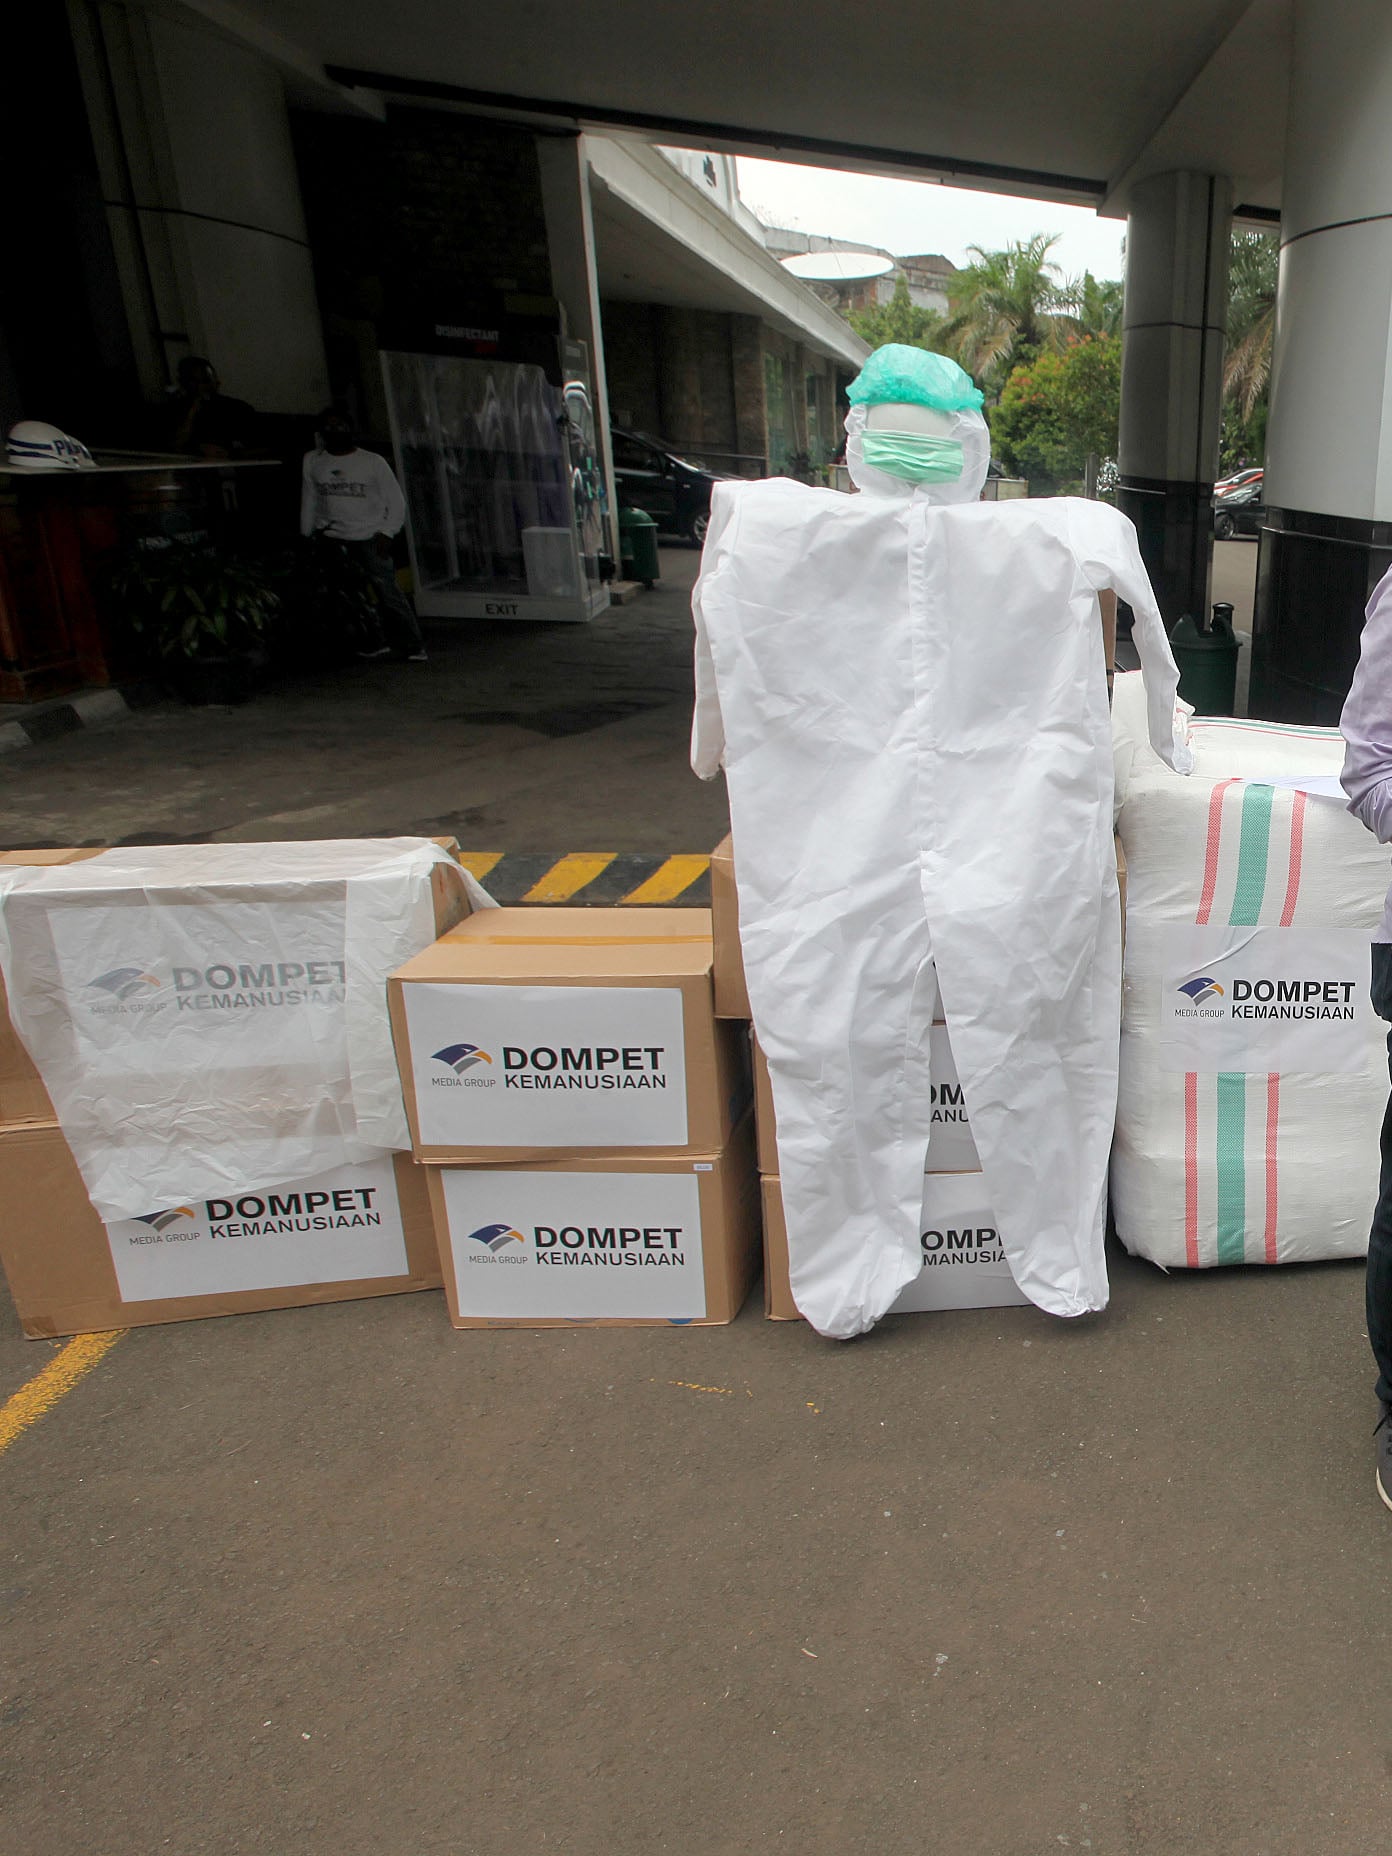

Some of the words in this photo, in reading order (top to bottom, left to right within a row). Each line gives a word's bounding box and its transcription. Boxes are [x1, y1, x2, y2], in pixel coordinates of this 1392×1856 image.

[486, 604, 518, 615] EXIT
[1232, 979, 1356, 1003] DOMPET
[1174, 1009, 1198, 1017] MEDIA
[1200, 1009, 1225, 1018] GROUP
[1231, 1005, 1354, 1020] KEMANUSIAAN
[502, 1046, 665, 1071] DOMPET
[432, 1077, 462, 1087] MEDIA
[464, 1078, 496, 1088] GROUP
[504, 1074, 667, 1090] KEMANUSIAAN
[205, 1188, 377, 1221] DOMPET
[209, 1213, 381, 1239] KEMANUSIAAN
[130, 1236, 163, 1246] MEDIA
[165, 1232, 201, 1243] GROUP
[533, 1226, 683, 1249] DOMPET
[921, 1228, 1002, 1250] OMP
[469, 1255, 497, 1264] MEDIA
[499, 1256, 528, 1265] GROUP
[536, 1251, 685, 1267] KEMANUSIAAN
[924, 1251, 1007, 1265] MANUSIA
